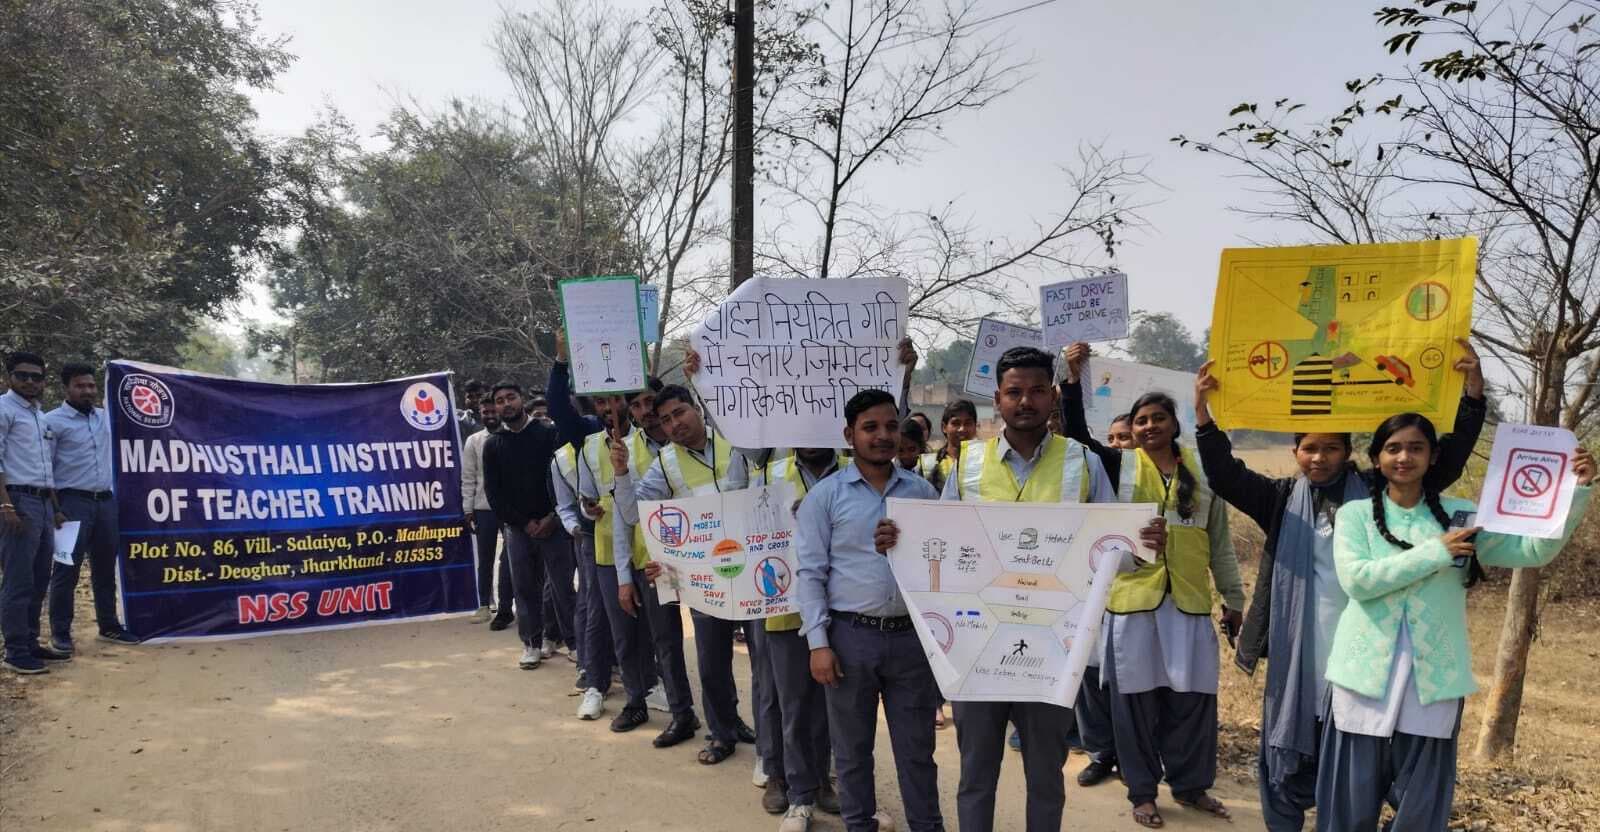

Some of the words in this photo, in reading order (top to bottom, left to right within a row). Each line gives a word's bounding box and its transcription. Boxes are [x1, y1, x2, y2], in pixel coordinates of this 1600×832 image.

[1046, 287, 1073, 303] FAST
[1081, 281, 1114, 298] DRIVE
[1062, 299, 1087, 312] COULD
[1090, 297, 1100, 308] BE
[861, 291, 904, 340] गति
[1047, 312, 1072, 327] LAST
[1079, 307, 1107, 321] DRIVE
[703, 376, 774, 418] नागरिक
[119, 439, 322, 476] MADHUSTHALI
[328, 440, 455, 473] INSTITUTE
[147, 488, 189, 522] OF
[197, 488, 326, 520] TEACHER
[328, 480, 445, 516] TRAINING
[129, 542, 169, 559] Plot
[174, 541, 207, 558] No.
[213, 538, 239, 558] 86,
[286, 532, 352, 553] Salaiya,
[396, 525, 464, 544] Madhupur
[745, 534, 768, 545] STOP
[749, 544, 763, 553] AND
[219, 561, 296, 581] Deoghar,
[300, 551, 384, 574] Jharkhand
[394, 546, 444, 564] 815353
[238, 592, 309, 624] NSS
[317, 581, 393, 616] UNIT
